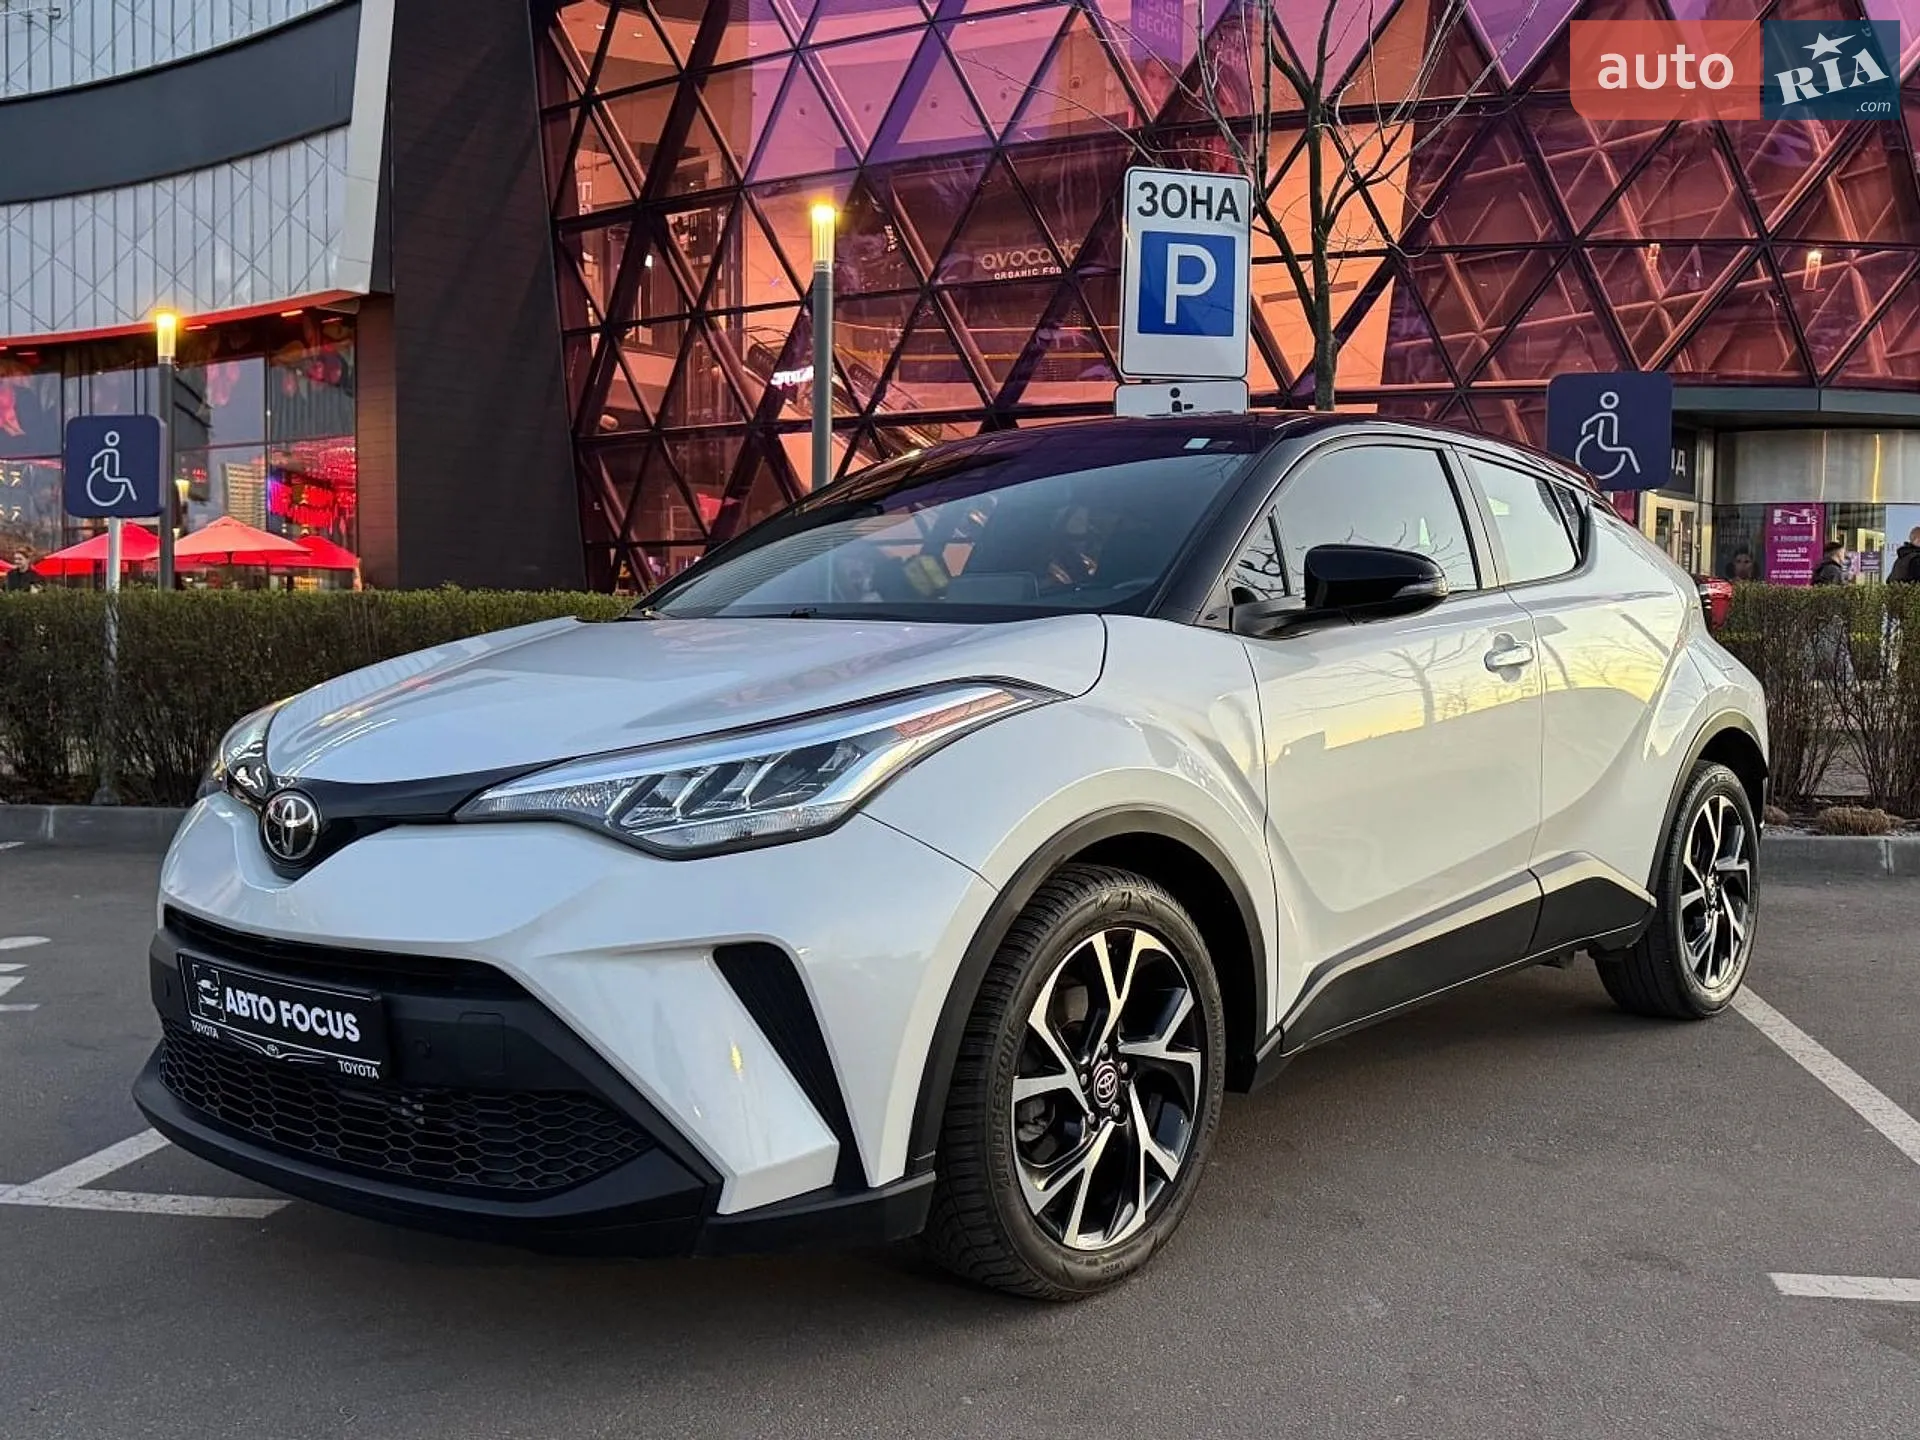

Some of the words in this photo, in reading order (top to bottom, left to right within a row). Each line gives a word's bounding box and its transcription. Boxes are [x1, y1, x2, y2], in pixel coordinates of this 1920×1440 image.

[1137, 181, 1241, 223] ЗОНА
[994, 268, 1038, 280] ORGANIC
[1042, 266, 1062, 275] FOO
[1164, 243, 1217, 324] P
[190, 1019, 220, 1040] TOYOTA
[225, 986, 277, 1025] АВТО
[280, 1001, 361, 1043] FOCUS
[338, 1060, 380, 1080] TOYOTA
